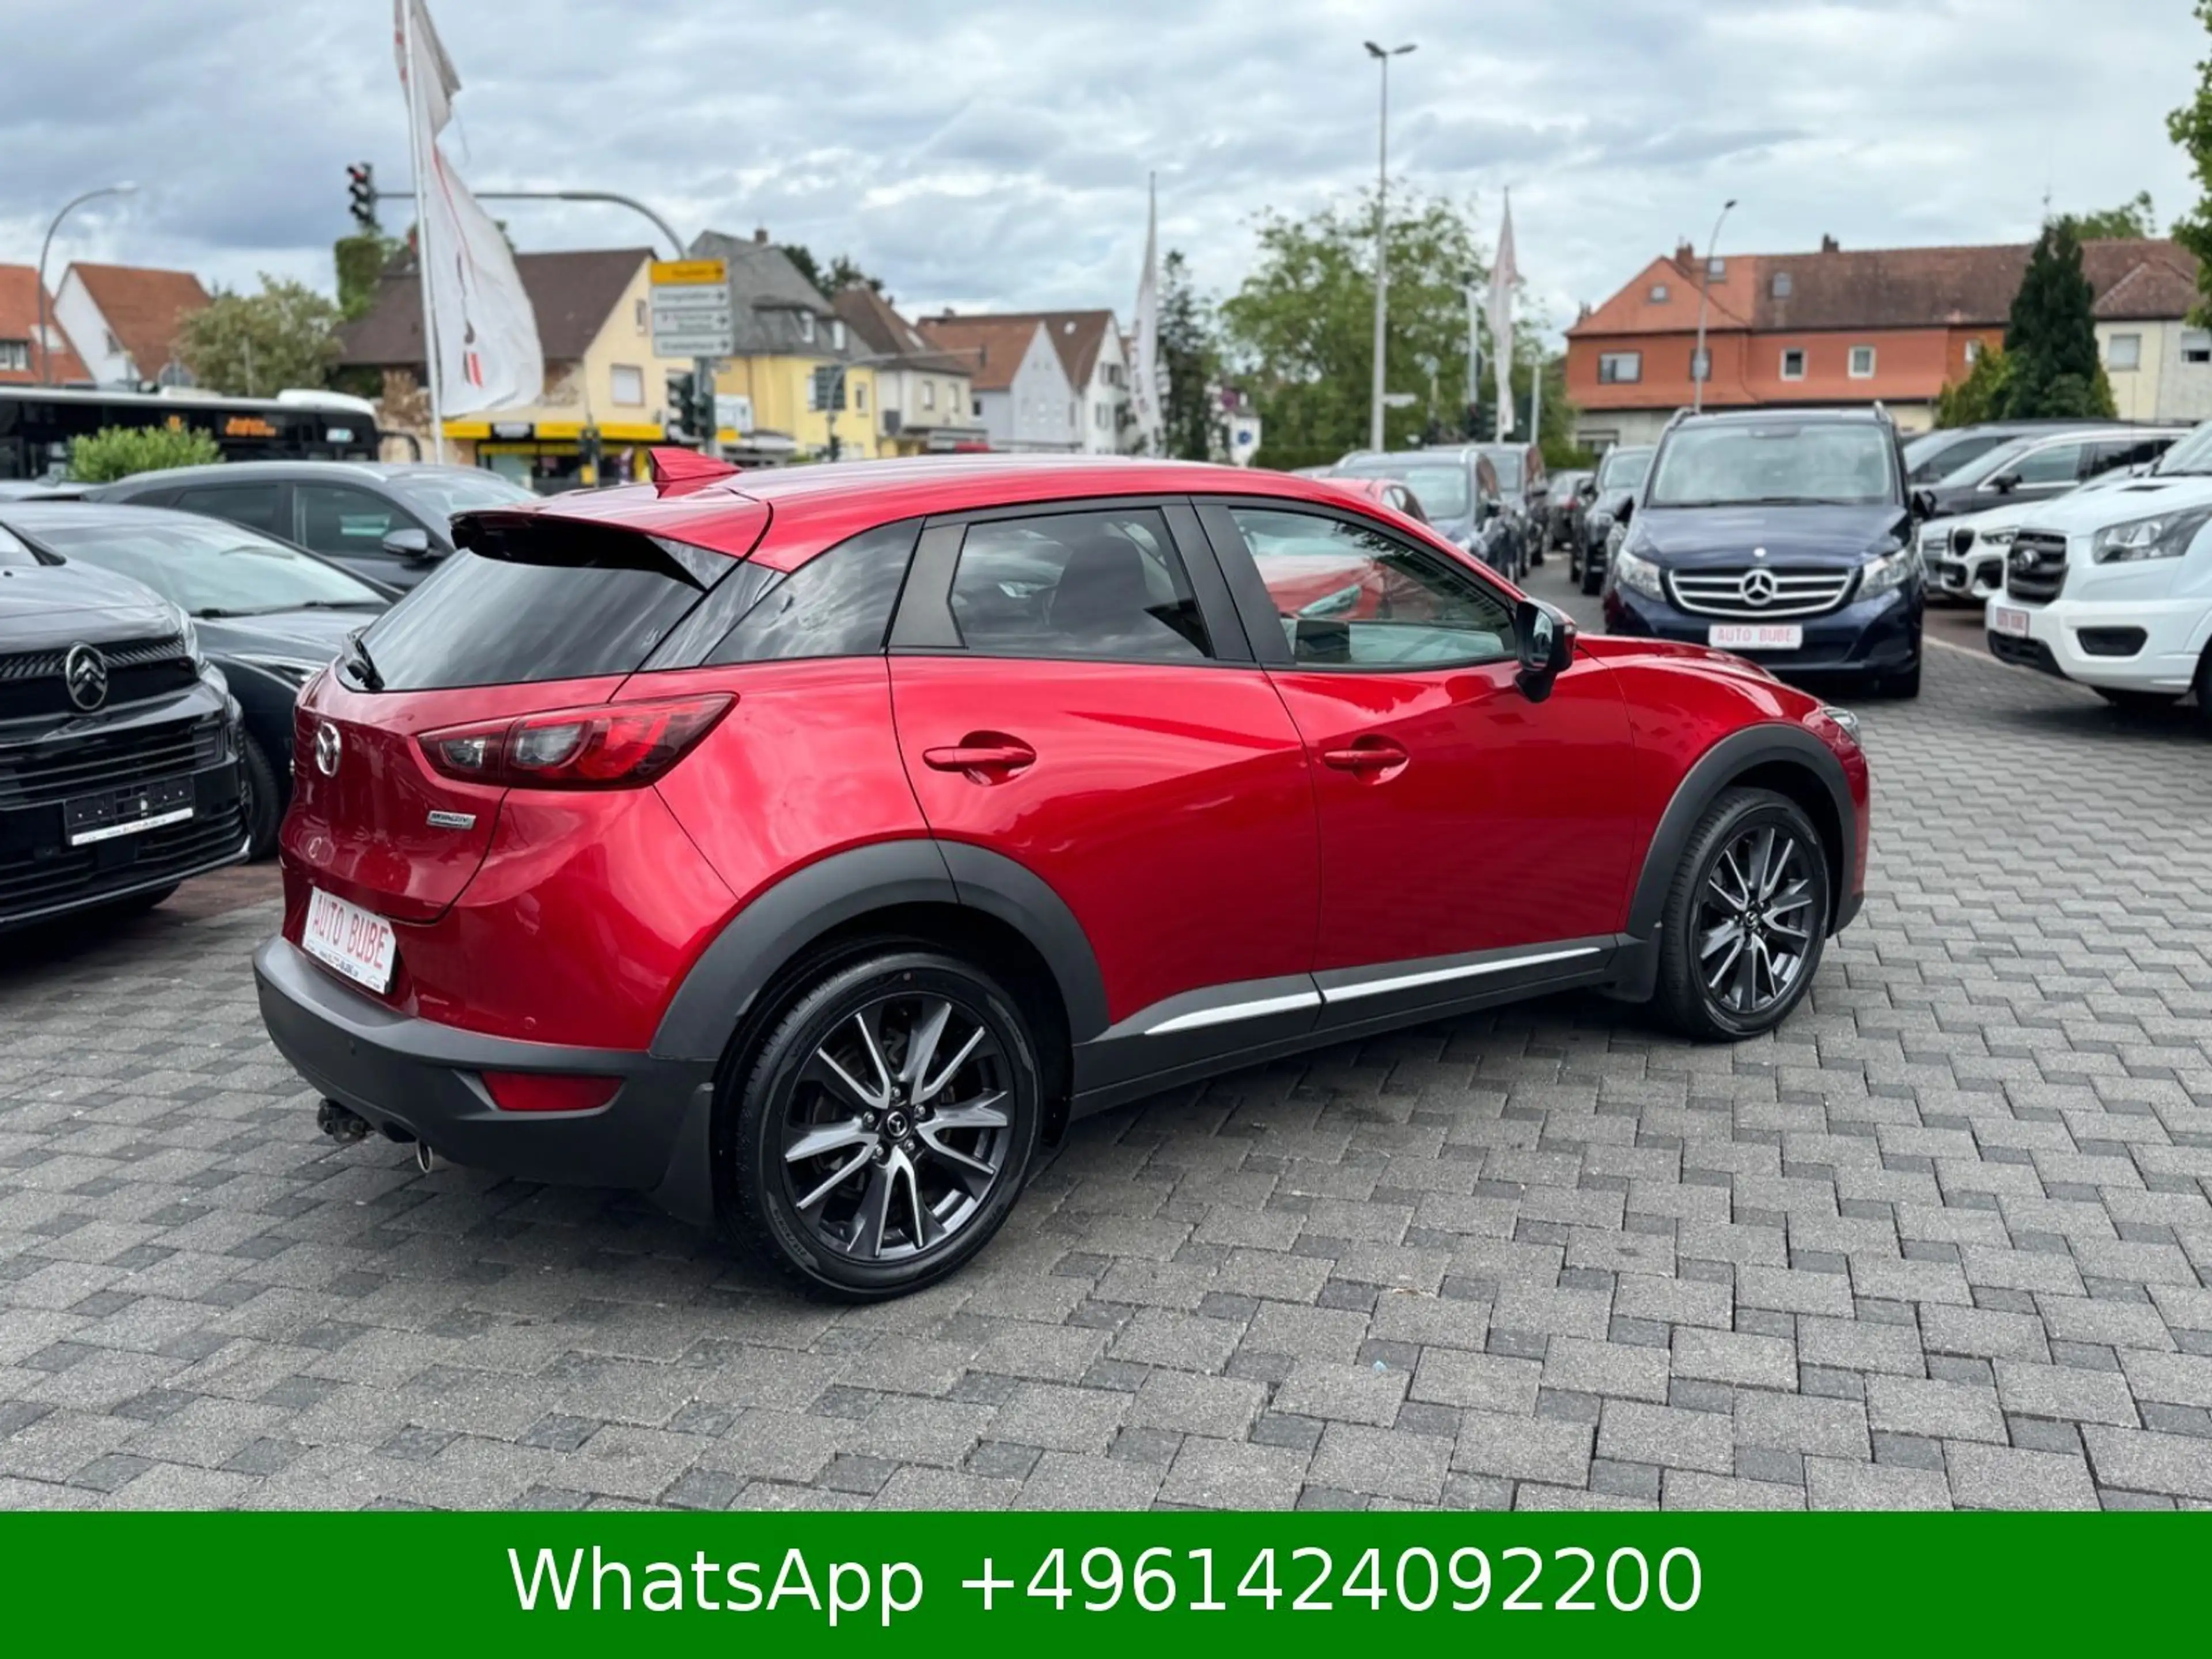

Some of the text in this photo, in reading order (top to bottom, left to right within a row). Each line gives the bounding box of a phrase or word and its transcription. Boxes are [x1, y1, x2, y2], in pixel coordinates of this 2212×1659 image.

[1717, 627, 1752, 642] AUTO
[313, 894, 345, 945] AUTO
[347, 913, 389, 969] BUBE
